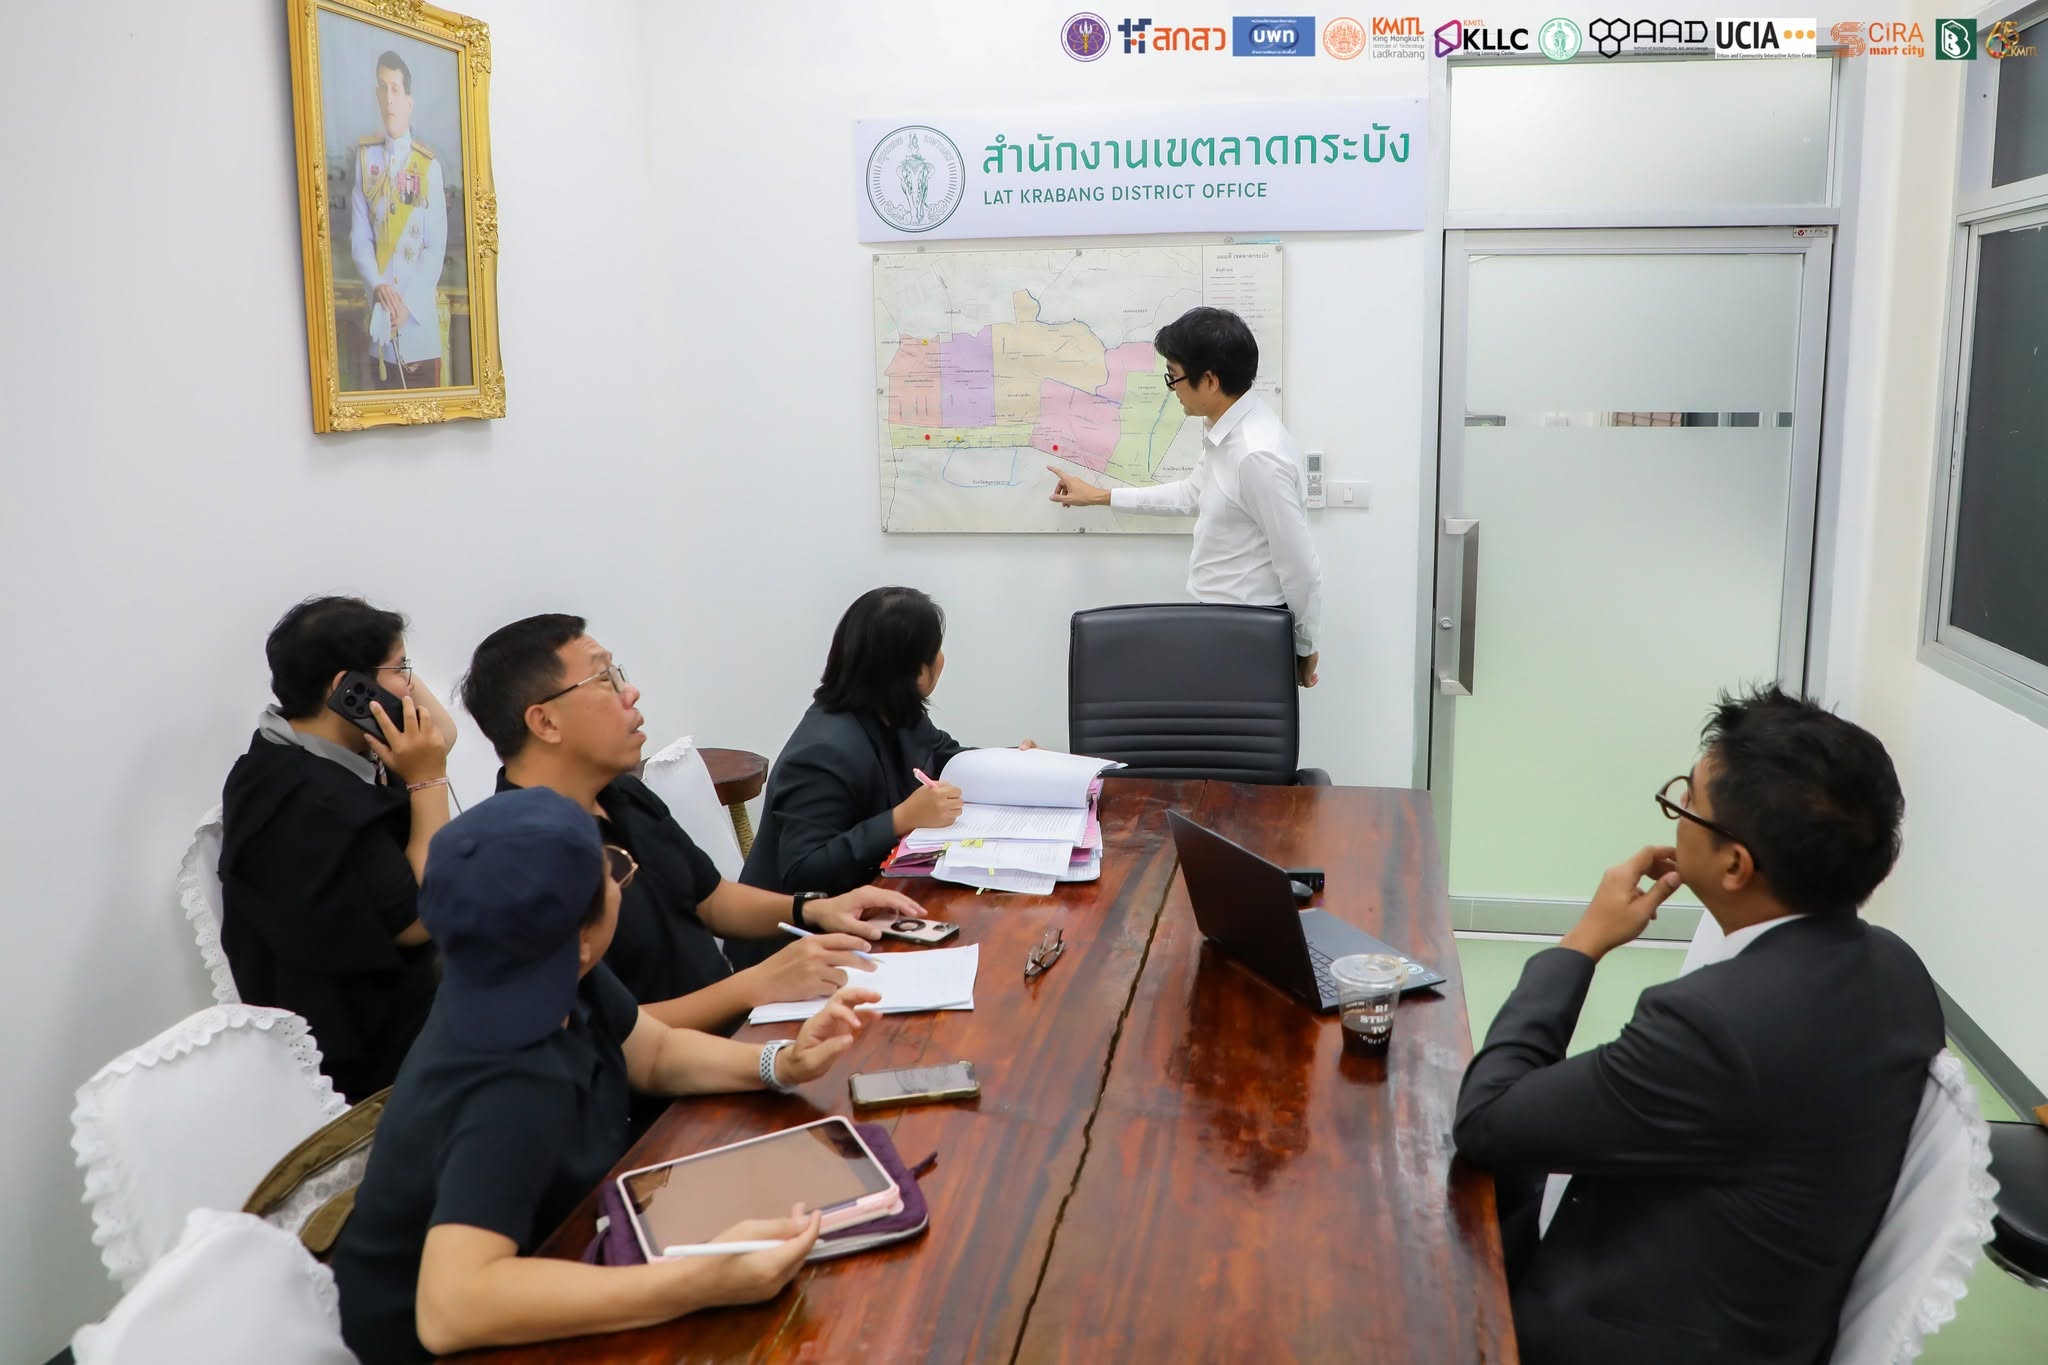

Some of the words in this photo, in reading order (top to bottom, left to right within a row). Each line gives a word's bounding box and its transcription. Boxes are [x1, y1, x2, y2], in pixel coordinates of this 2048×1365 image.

[982, 122, 1411, 175] สำนักงานเขตลาดกระบัง
[984, 190, 1013, 205] LAT
[1020, 186, 1104, 204] KRABANG
[1112, 183, 1196, 202] DISTRICT
[1202, 182, 1268, 199] OFFICE
[1371, 1025, 1386, 1035] TO
